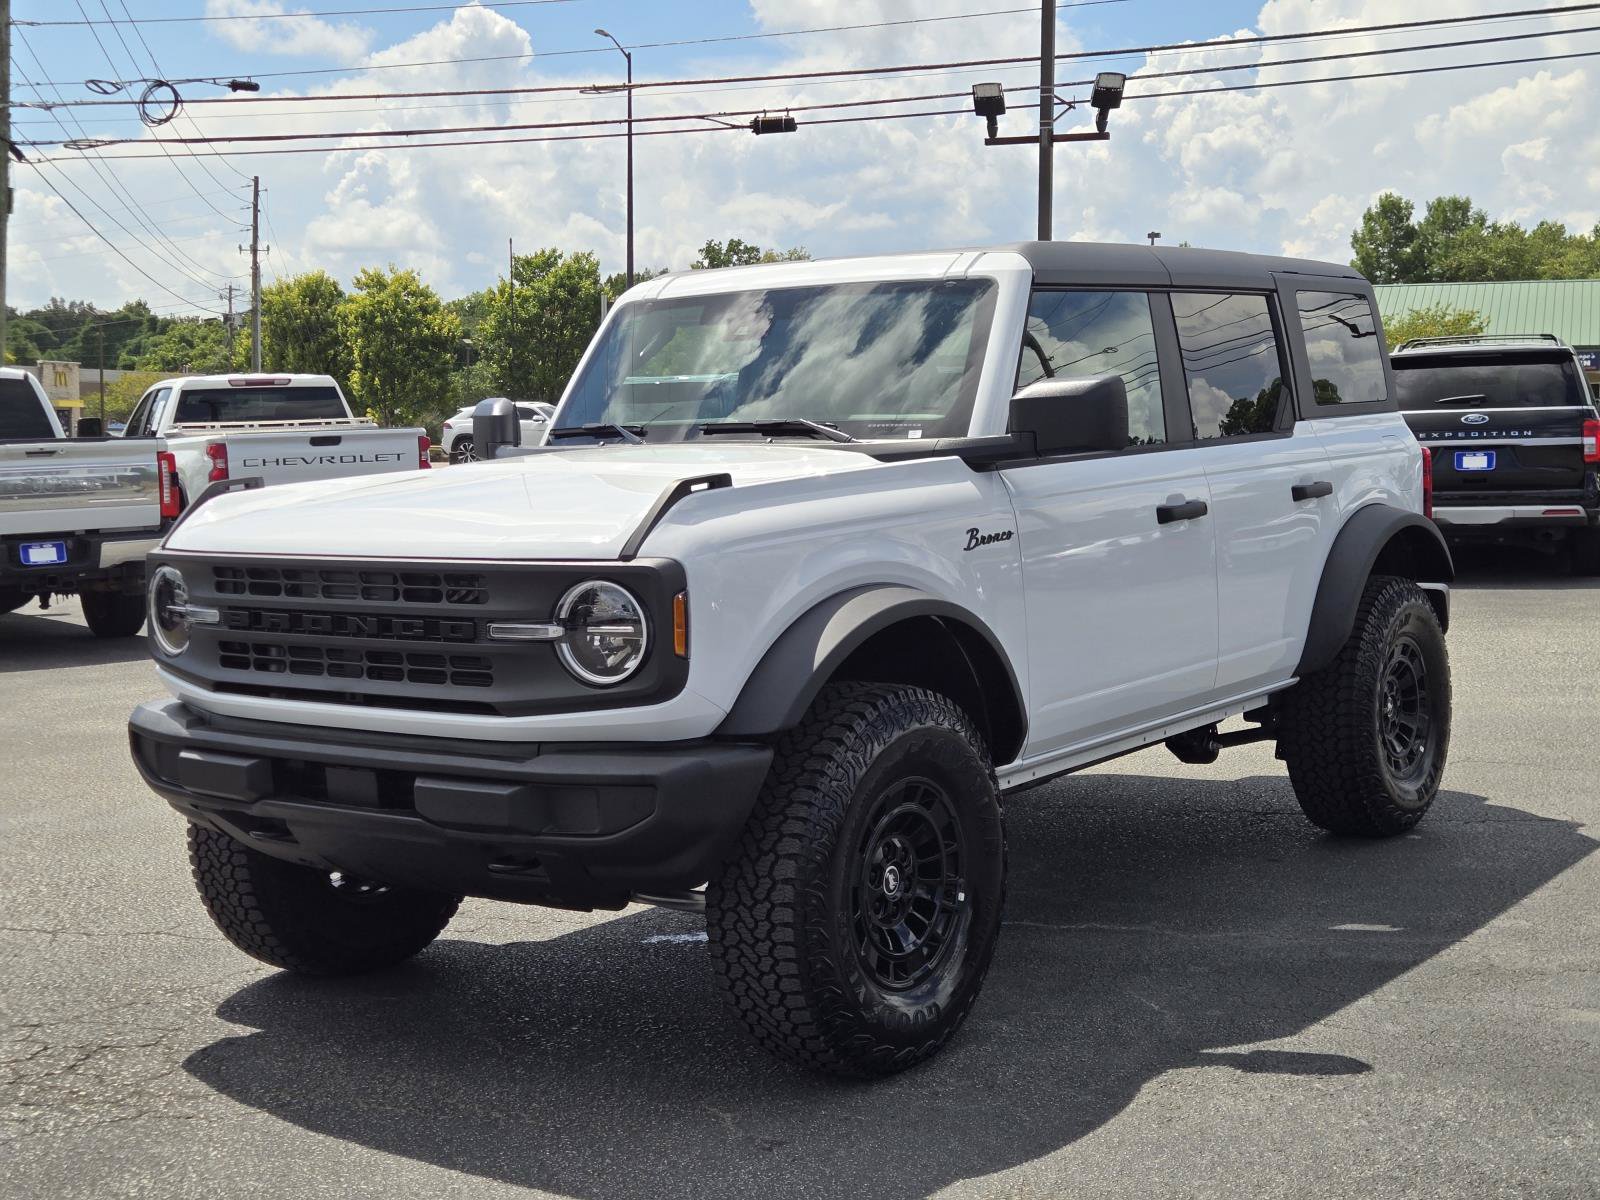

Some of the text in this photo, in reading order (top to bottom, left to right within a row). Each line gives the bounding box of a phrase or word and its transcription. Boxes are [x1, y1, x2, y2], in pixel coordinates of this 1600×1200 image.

[1419, 430, 1532, 438] EXPEDITION
[243, 453, 406, 468] CHEVROLET
[963, 527, 1014, 551] Bronco
[222, 610, 474, 641] BRONCO
